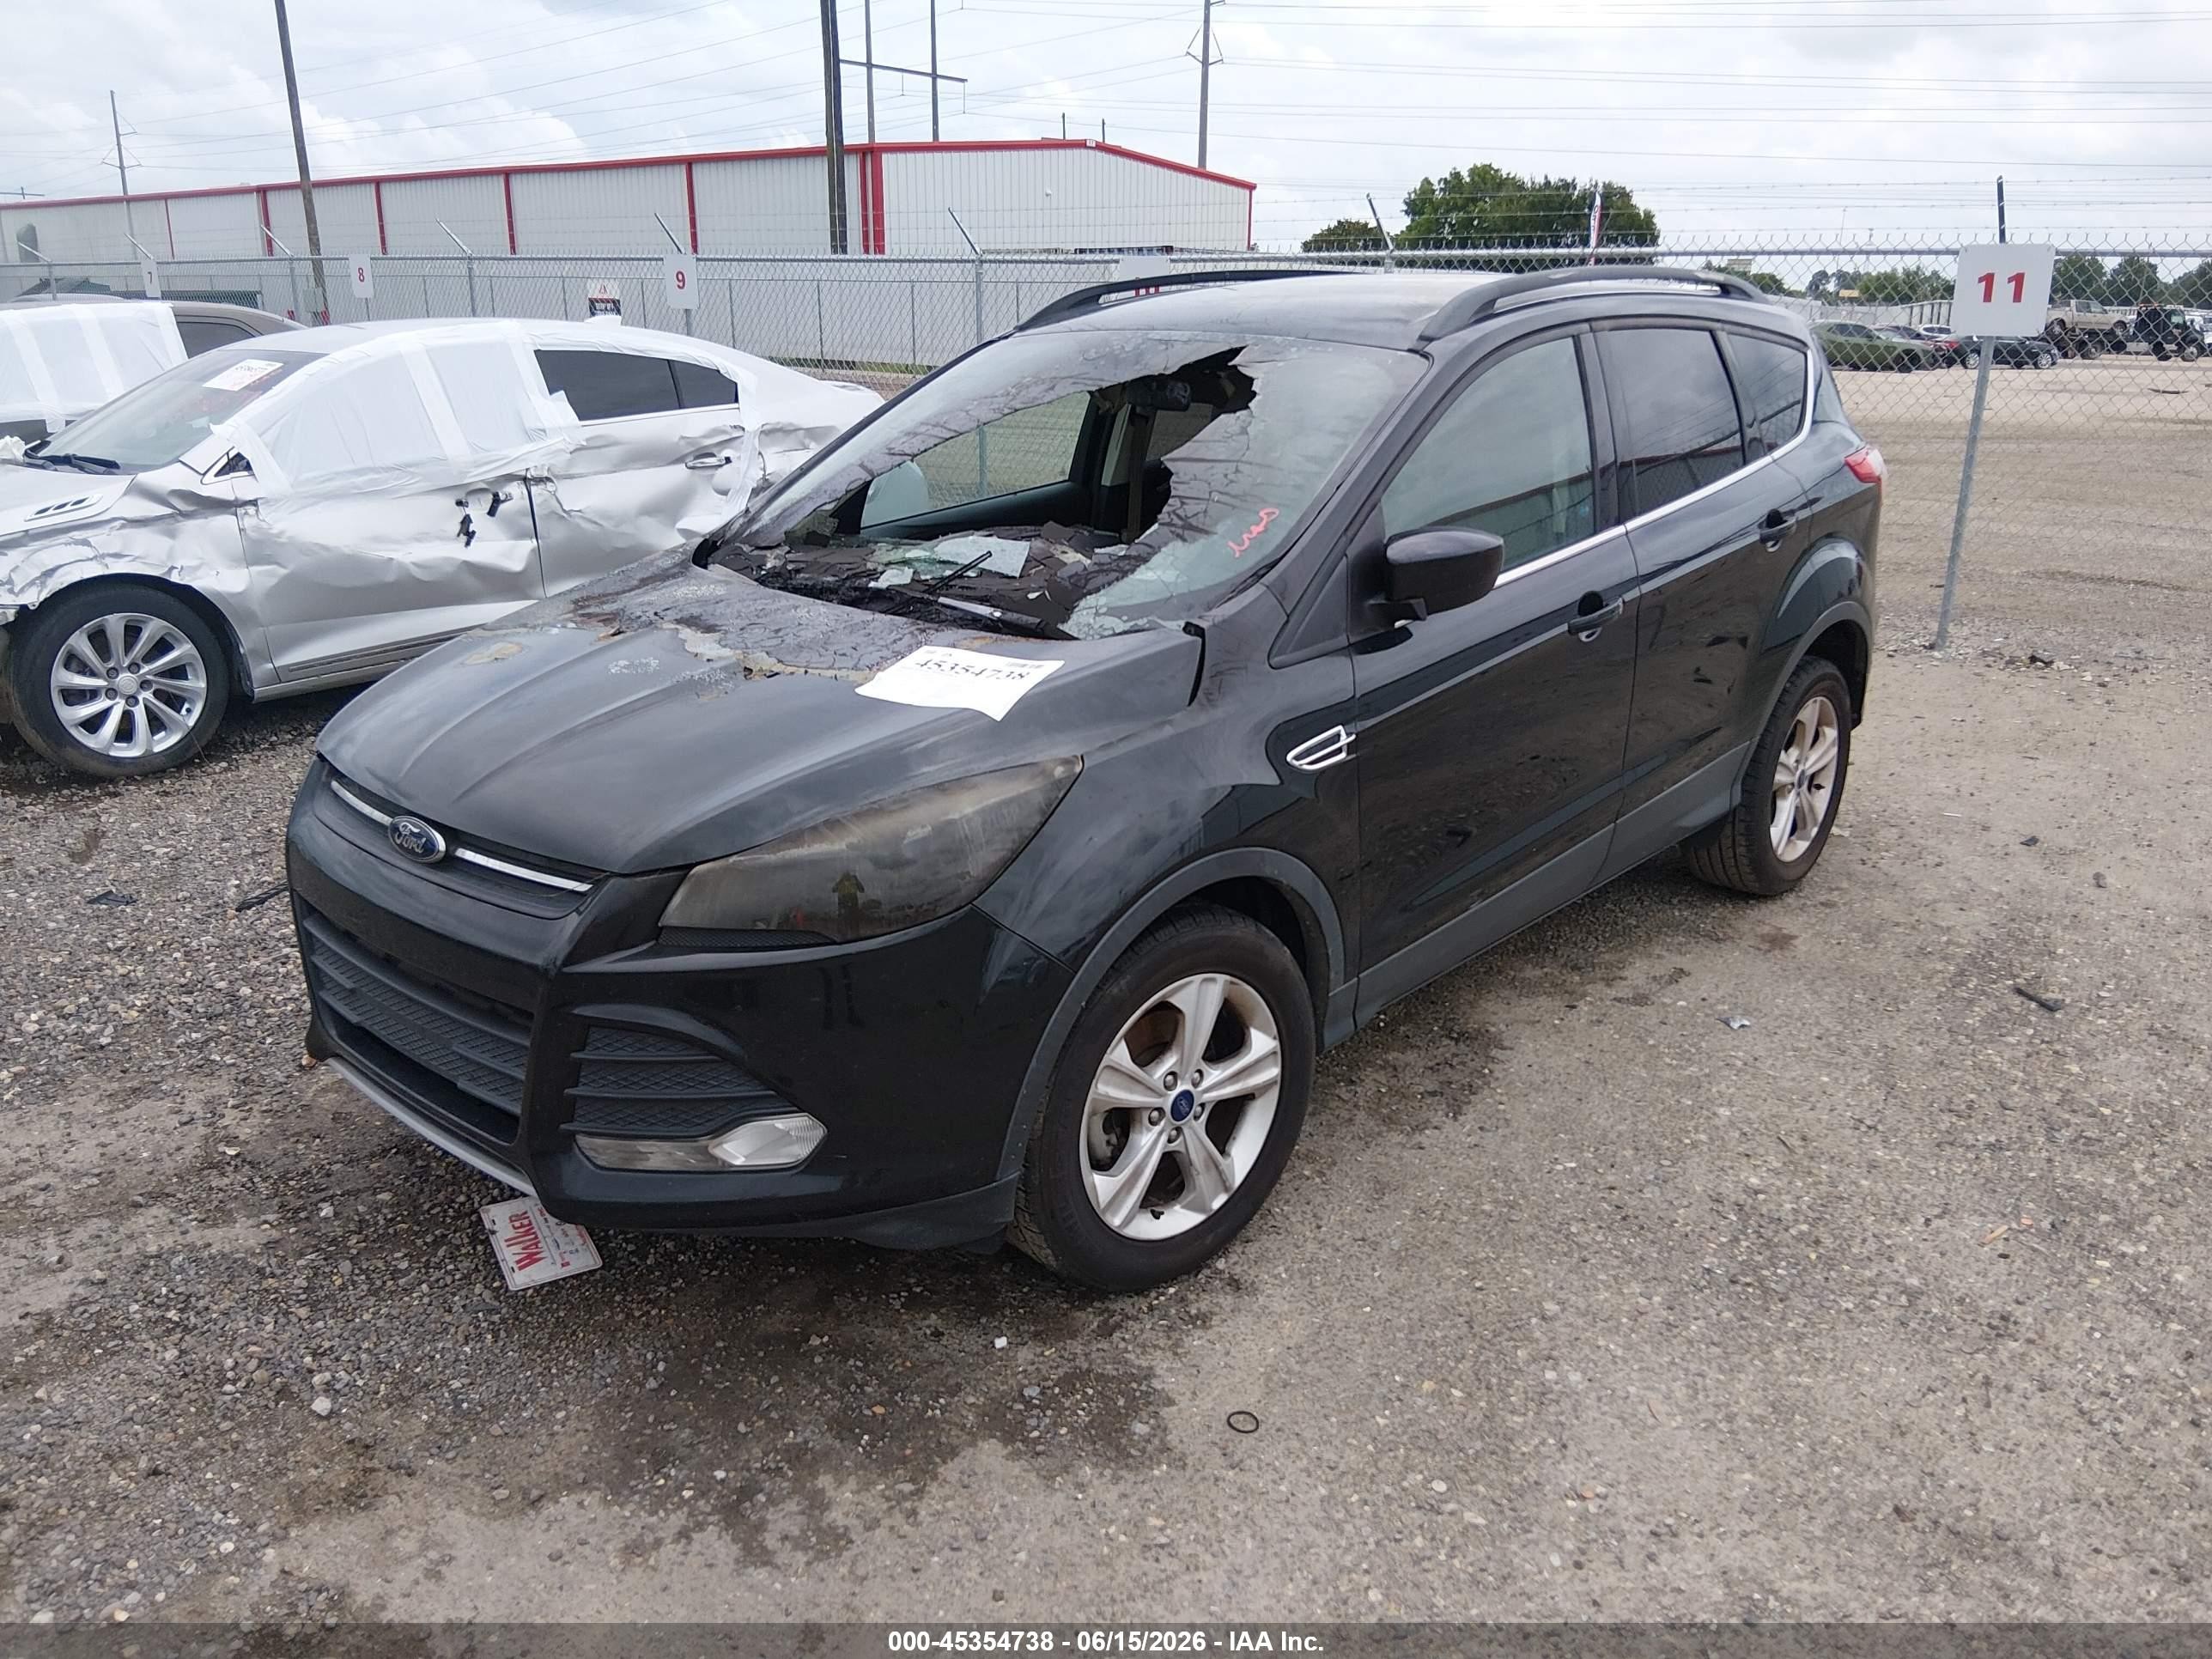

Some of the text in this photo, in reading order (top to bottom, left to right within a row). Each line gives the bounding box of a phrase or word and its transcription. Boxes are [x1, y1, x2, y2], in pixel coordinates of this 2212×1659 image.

[357, 267, 365, 283] 8
[675, 270, 686, 290] 9
[1978, 272, 2026, 304] 11
[915, 658, 1030, 681] 45354738
[394, 821, 428, 854] Ford
